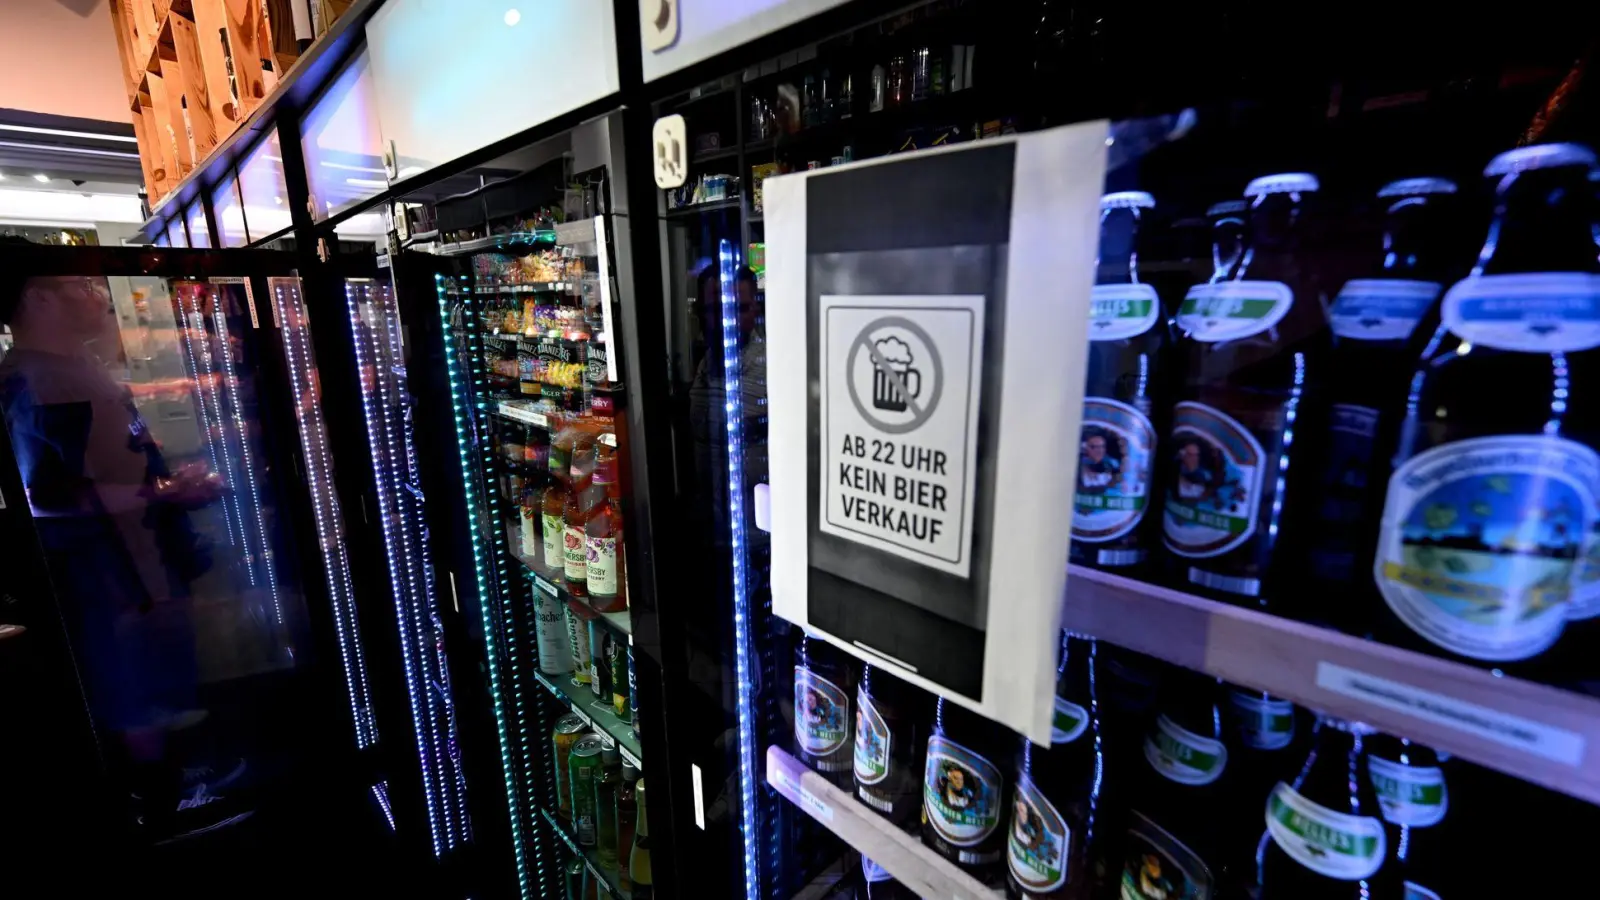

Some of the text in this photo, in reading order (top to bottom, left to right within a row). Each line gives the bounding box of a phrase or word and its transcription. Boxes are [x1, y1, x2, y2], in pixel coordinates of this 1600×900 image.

[842, 434, 947, 476] AB 22 UHR
[840, 463, 947, 512] KEIN BIER
[841, 494, 943, 543] VERKAUF
